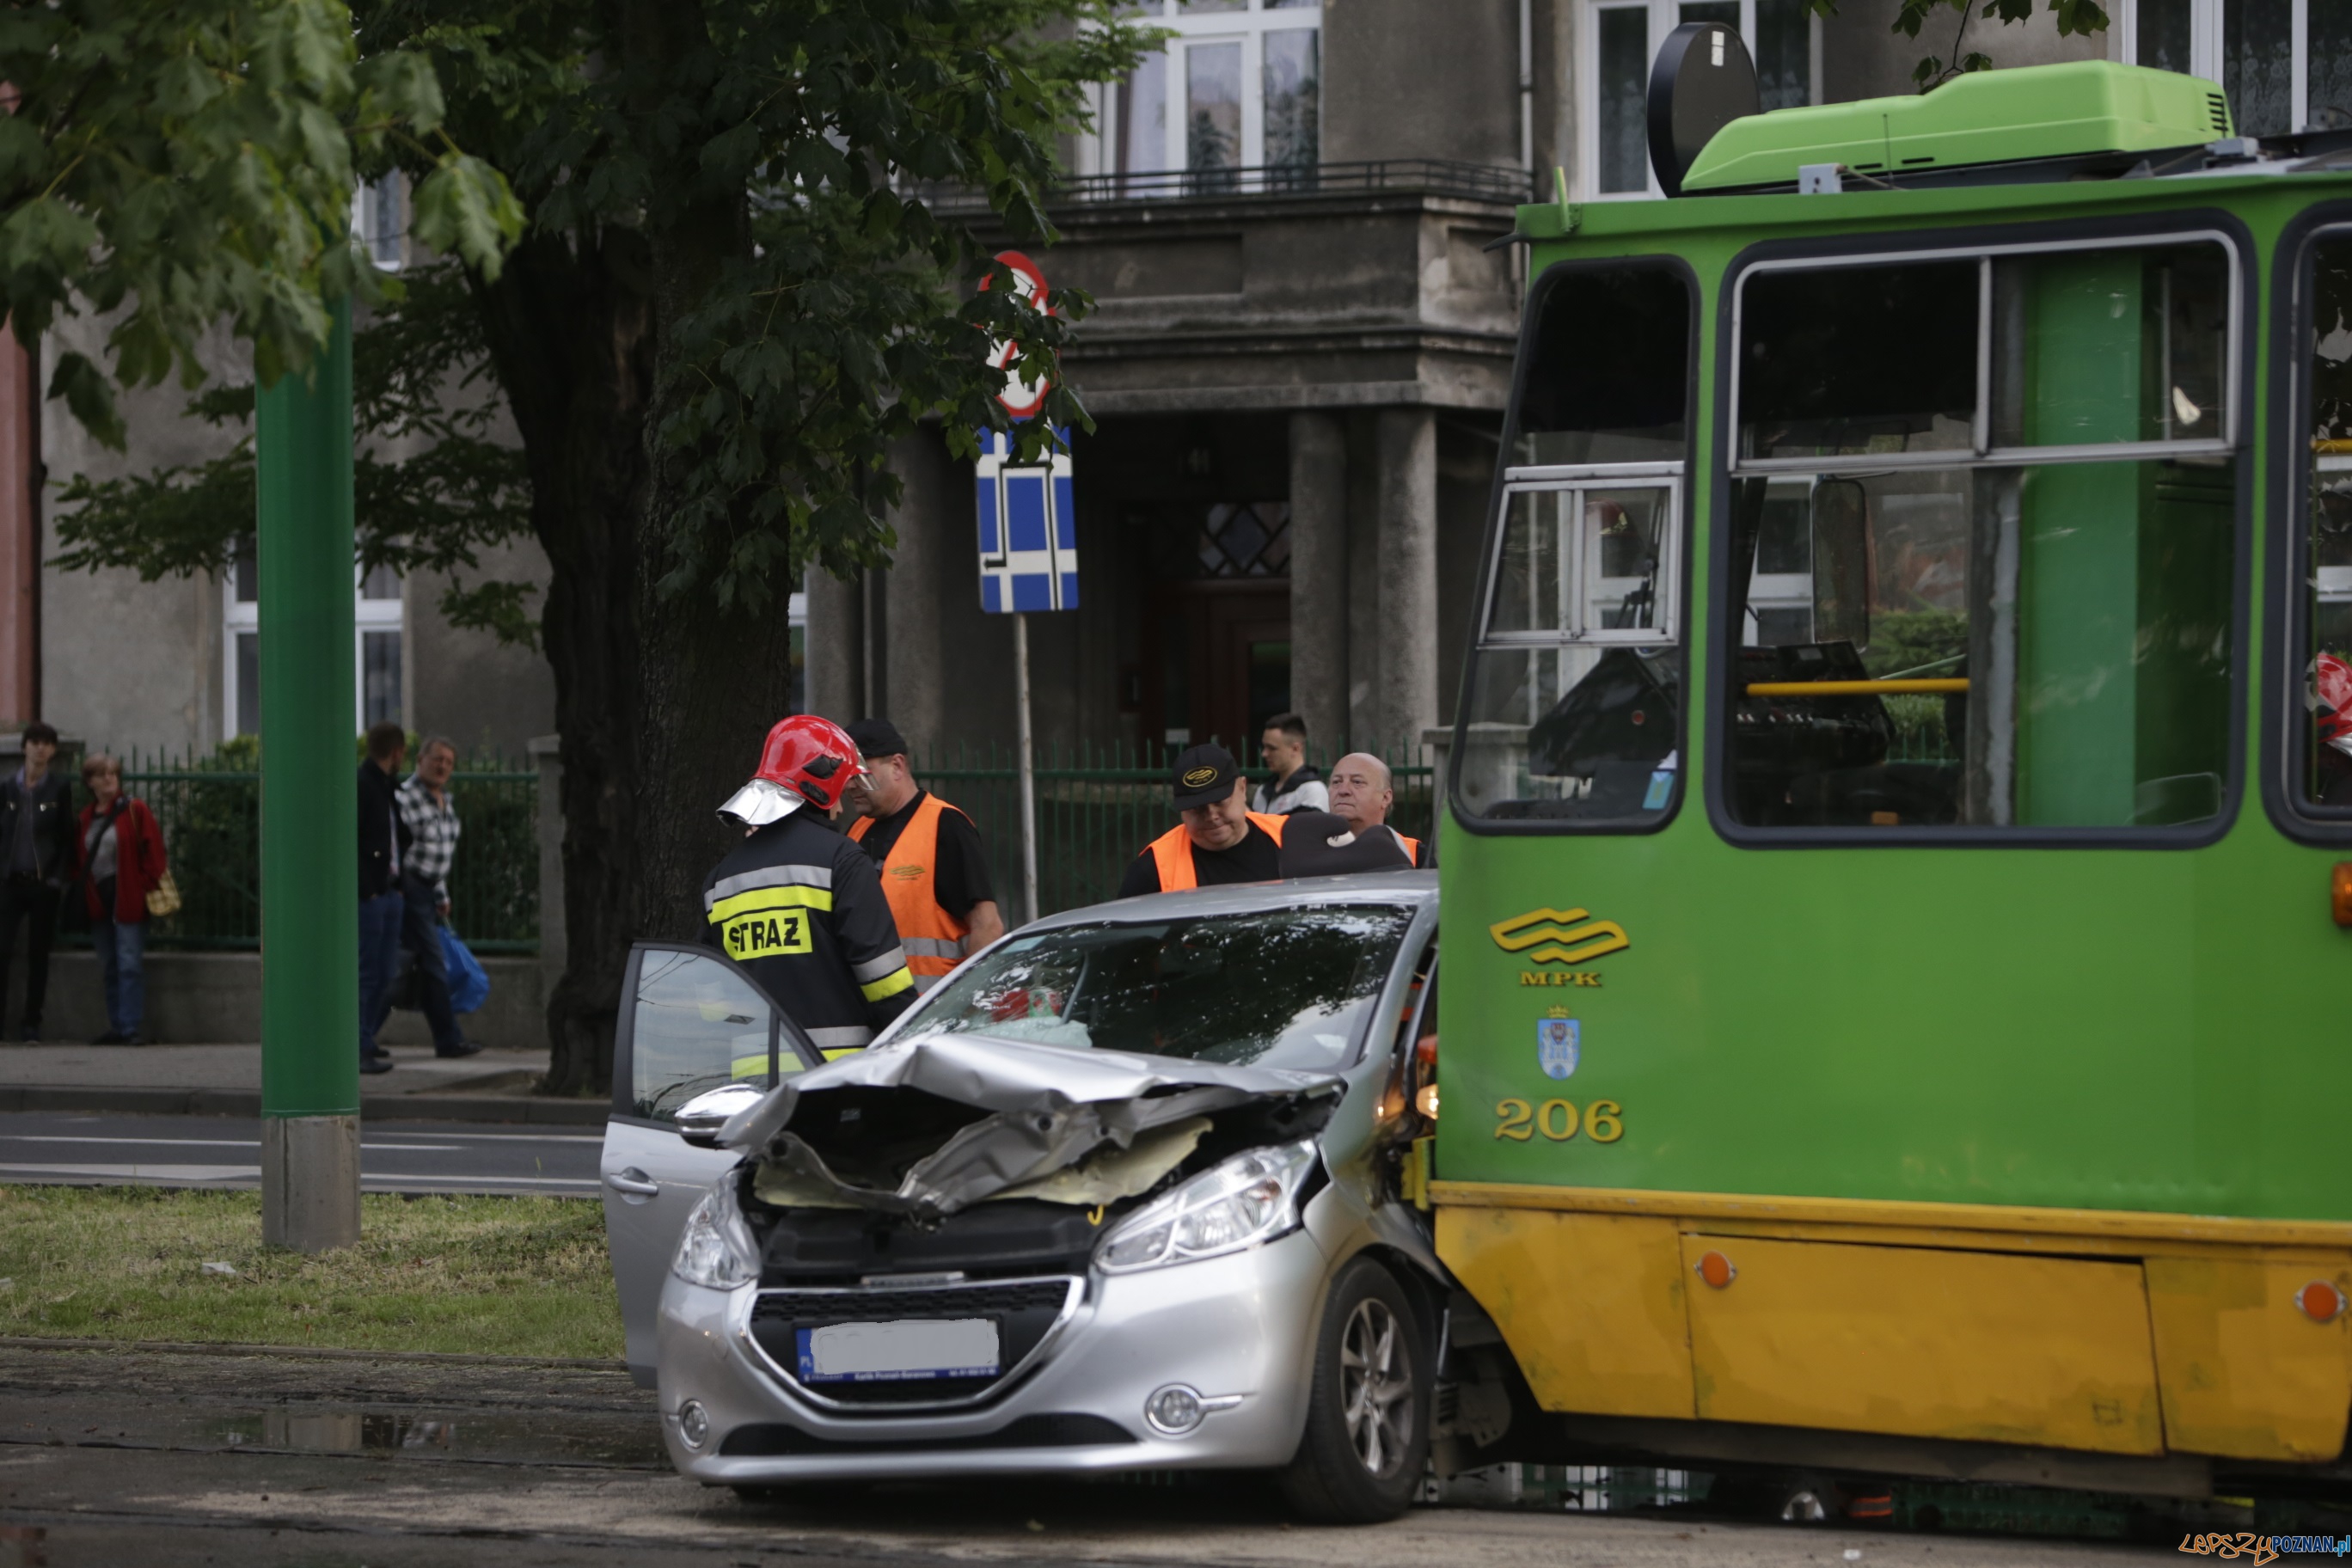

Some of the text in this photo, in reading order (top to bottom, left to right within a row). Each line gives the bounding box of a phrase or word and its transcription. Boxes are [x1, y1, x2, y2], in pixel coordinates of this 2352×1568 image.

[1520, 971, 1602, 987] MPK
[1494, 1098, 1624, 1143] 206
[800, 1356, 812, 1368] PL
